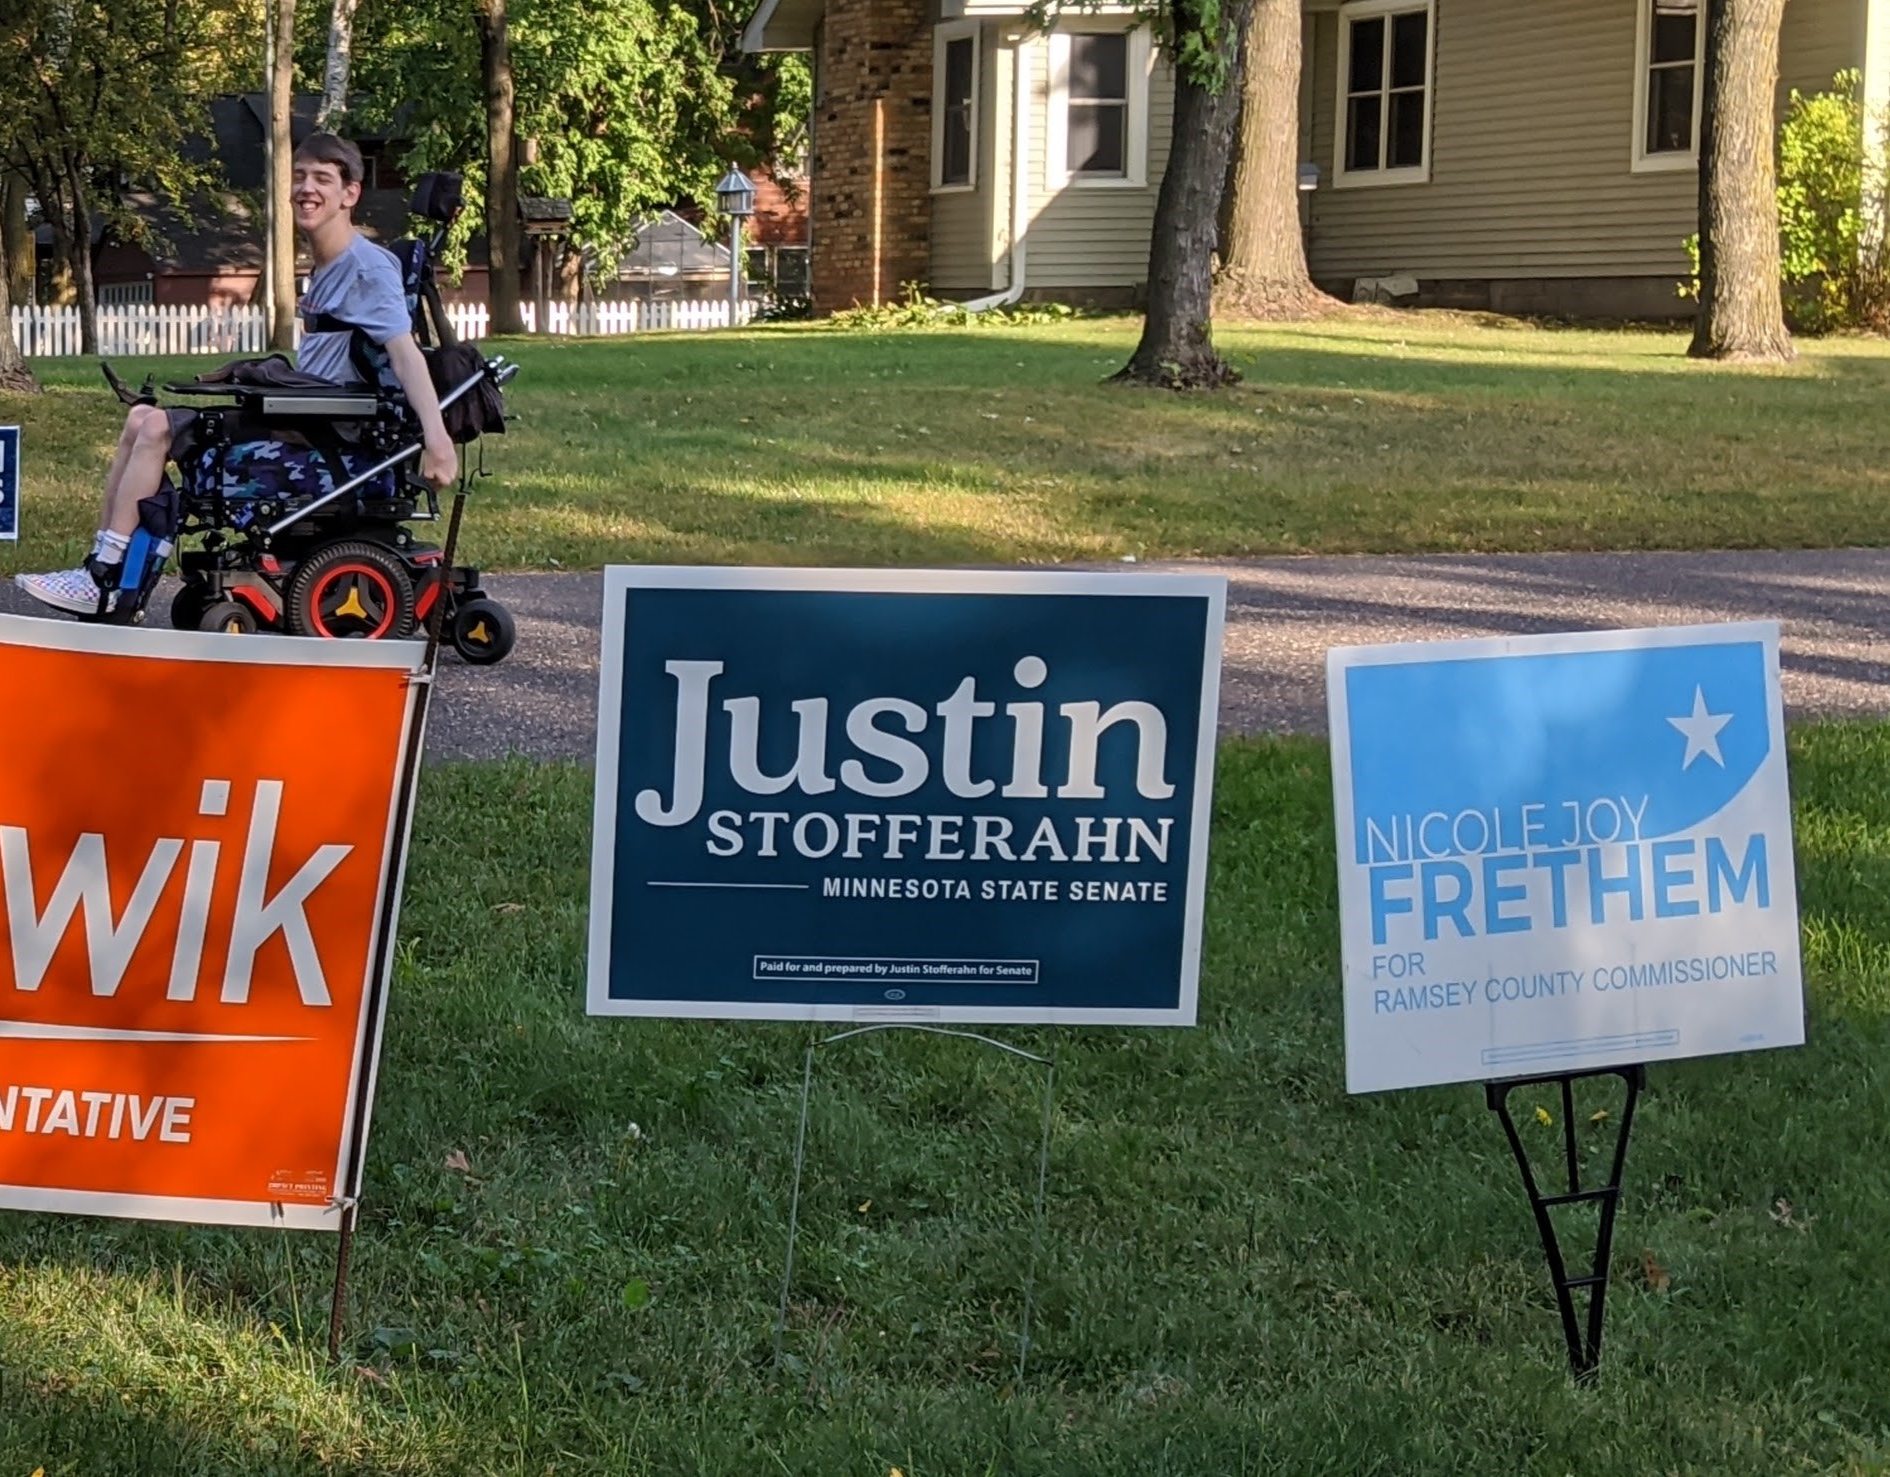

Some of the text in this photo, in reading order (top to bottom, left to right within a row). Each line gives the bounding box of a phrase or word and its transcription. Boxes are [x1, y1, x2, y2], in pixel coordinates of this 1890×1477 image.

[635, 655, 1176, 828] Justin
[706, 810, 1174, 864] STOFFERAHN
[1366, 795, 1648, 862] NICOLE JOY
[823, 876, 1168, 903] MINNESOTA STATE SENATE
[1370, 833, 1770, 945] FRETHEM
[760, 961, 1033, 976] Paid for and prepared by Justin Stofferahn for Senate
[1373, 952, 1426, 980] FOR
[1375, 950, 1777, 1014] RAMSEY COUNTY COMMISSIONER
